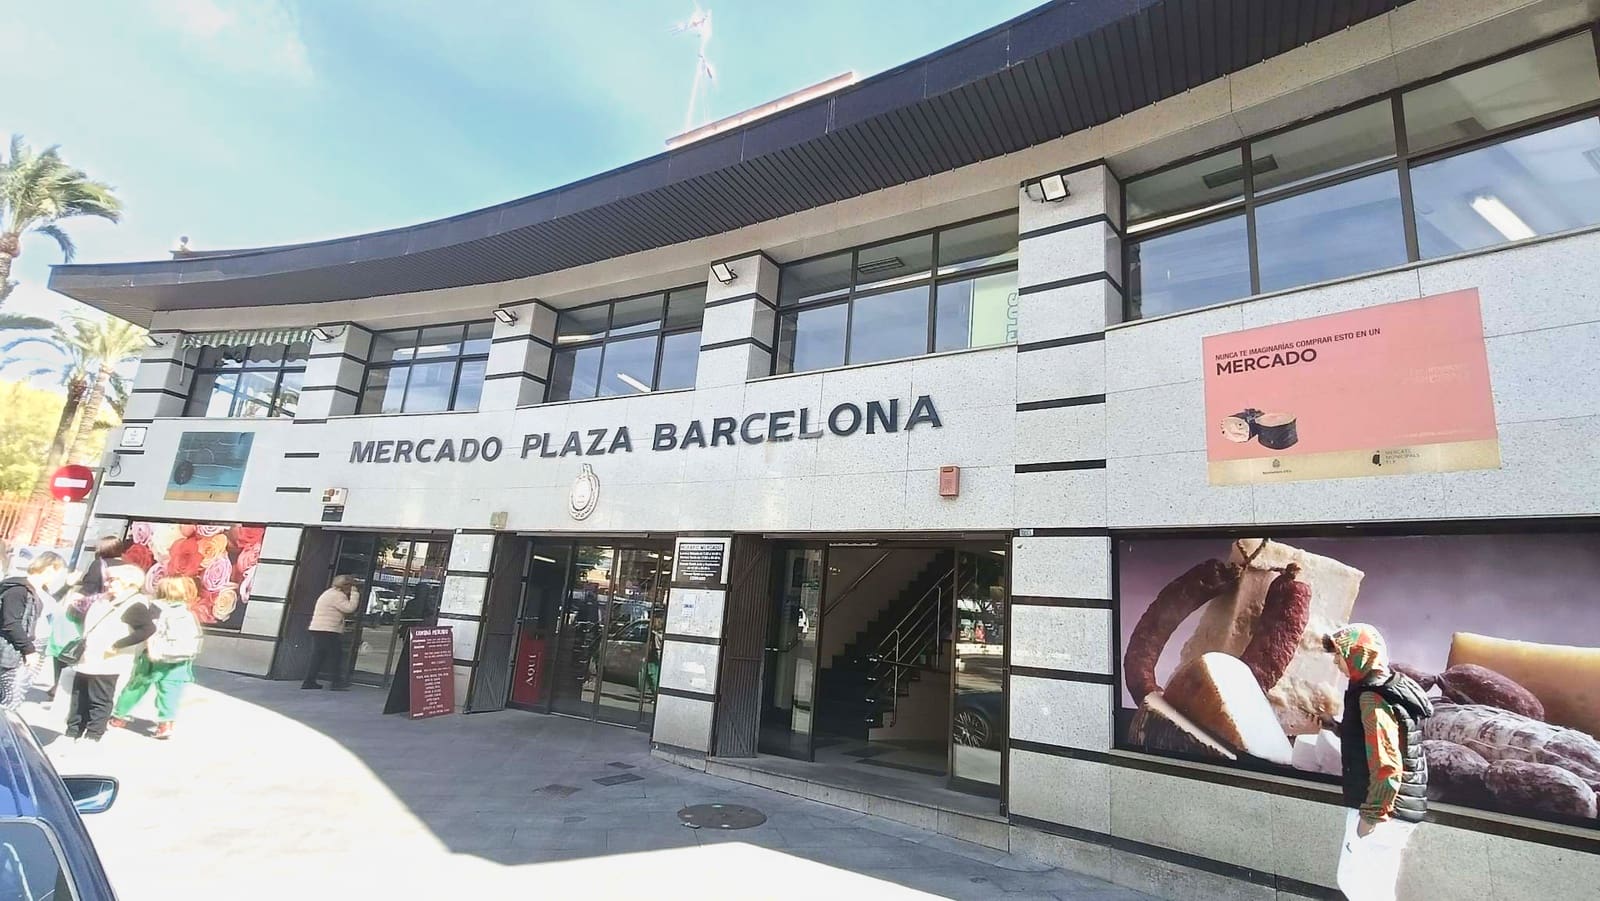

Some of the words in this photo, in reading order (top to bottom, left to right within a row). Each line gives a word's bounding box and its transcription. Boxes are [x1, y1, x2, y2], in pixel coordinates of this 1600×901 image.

[1215, 351, 1238, 360] NUNCA
[1240, 349, 1247, 357] TE
[1249, 342, 1294, 355] IMAGINARÍAS
[1296, 335, 1333, 348] COMPRAR
[1334, 332, 1354, 342] ESTO
[1356, 330, 1367, 338] EN
[1368, 328, 1381, 336] UN
[1216, 348, 1317, 376] MERCADO
[349, 436, 502, 464] MERCADO
[520, 425, 633, 459] PLAZA
[652, 394, 943, 451] BARCELONA
